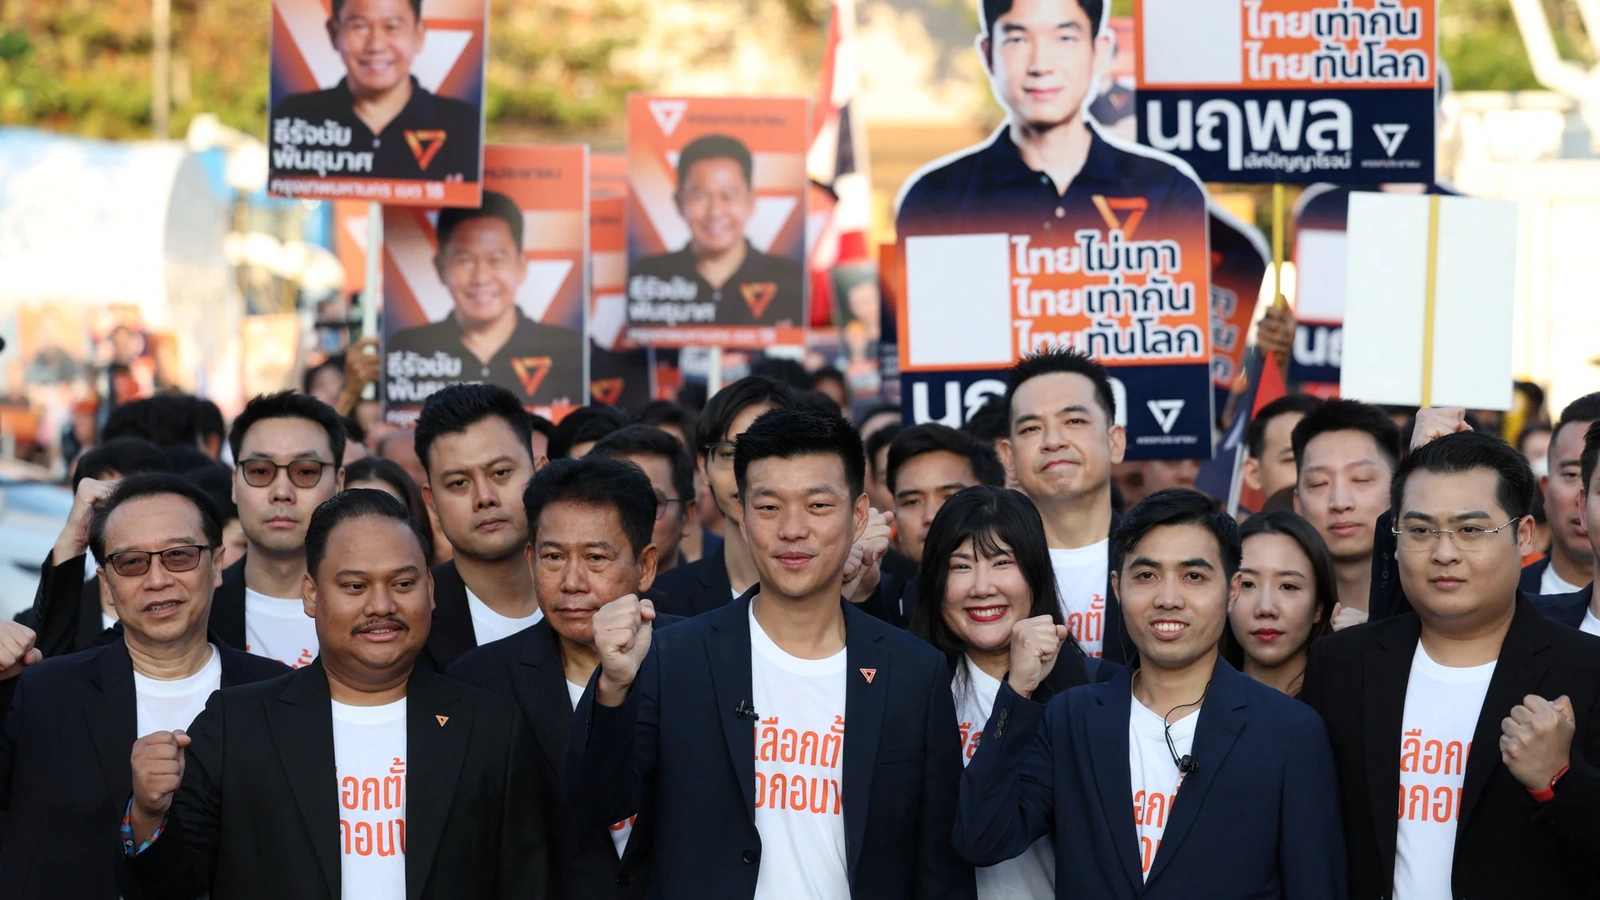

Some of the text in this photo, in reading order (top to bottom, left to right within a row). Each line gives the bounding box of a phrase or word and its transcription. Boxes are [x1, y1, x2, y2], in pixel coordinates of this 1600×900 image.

[1146, 98, 1353, 171] นฤพล
[1400, 729, 1472, 775] ลือก
[755, 772, 843, 815] อกอนา
